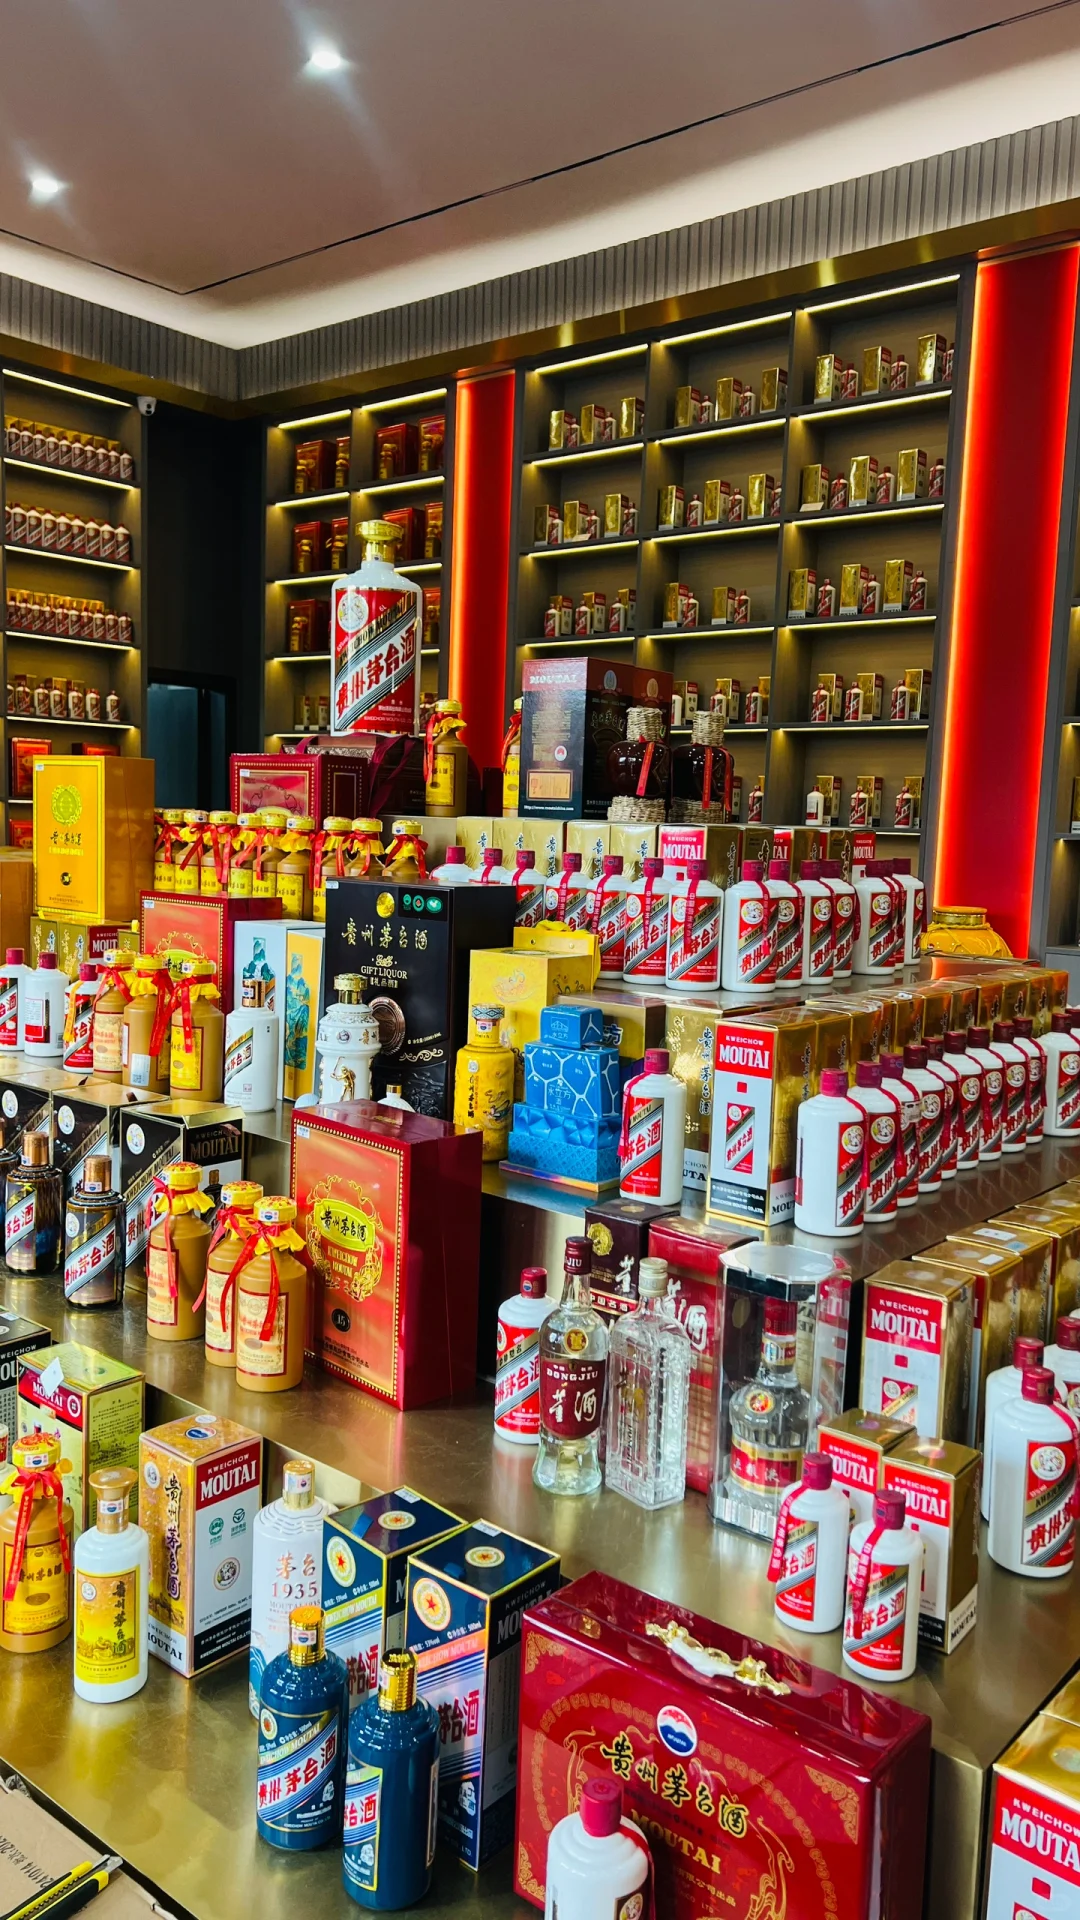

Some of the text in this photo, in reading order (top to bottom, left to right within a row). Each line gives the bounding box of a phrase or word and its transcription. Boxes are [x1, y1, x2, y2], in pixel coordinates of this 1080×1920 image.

[336, 624, 416, 720] 贵州茅台酒
[663, 843, 702, 860] MOUTAI
[853, 847, 874, 859] MOUTAI
[341, 917, 428, 950] 贵州茅台酒
[361, 965, 408, 980] GIFT LIQUOR
[726, 1035, 764, 1046] KWEICHOW
[697, 1026, 712, 1116] 贵州茅台酒
[719, 1044, 770, 1070] MOUTAI
[190, 1135, 240, 1161] MOUTAI
[321, 1206, 367, 1243] 贵州茅台酒
[65, 1229, 115, 1287] 贵州茅台酒
[590, 1292, 628, 1312] 中国名酒
[879, 1298, 930, 1316] KWEICHOW
[337, 1314, 346, 1326] 15
[870, 1308, 938, 1345] MOUTAI
[546, 1367, 598, 1382] DONGJIU
[549, 1382, 597, 1423] 董酒
[207, 1452, 250, 1475] KWEICHOW
[200, 1460, 257, 1501] MOUTAI
[894, 1476, 939, 1494] KWEICHOW
[163, 1472, 183, 1601] 贵州茅台酒
[275, 1551, 317, 1581] 茅台
[271, 1580, 319, 1600] 1935
[111, 1580, 128, 1656] 贵州茅台酒
[258, 1733, 336, 1807] 贵州茅台酒
[599, 1729, 750, 1839] 贵州茅台酒
[1013, 1797, 1080, 1840] KWEICHOW
[631, 1808, 721, 1875] MOUTAI
